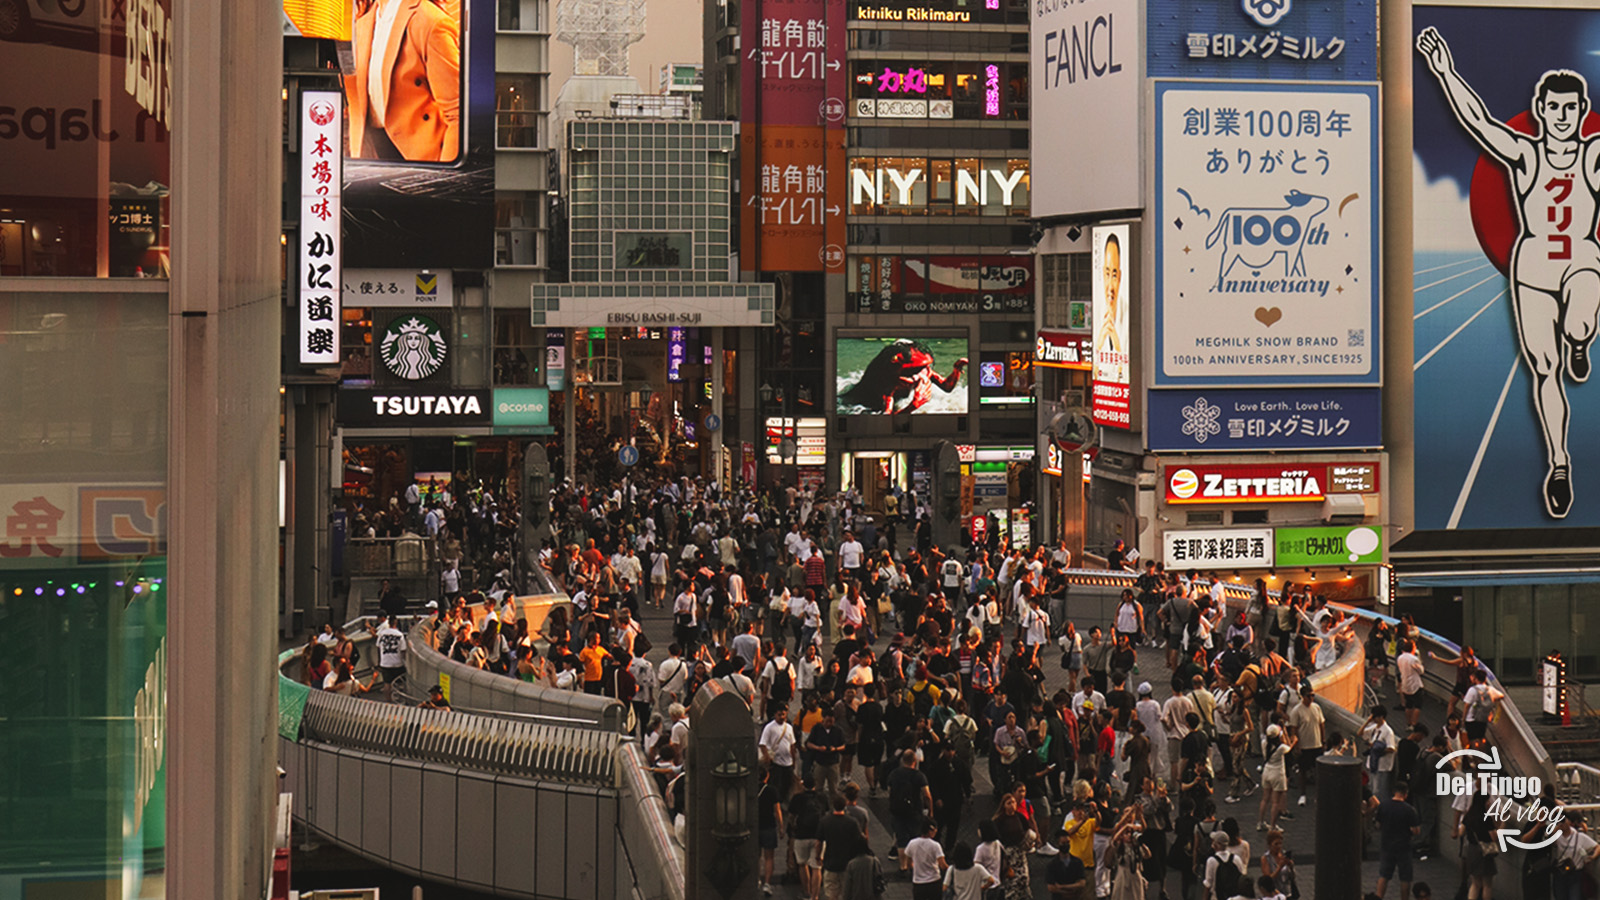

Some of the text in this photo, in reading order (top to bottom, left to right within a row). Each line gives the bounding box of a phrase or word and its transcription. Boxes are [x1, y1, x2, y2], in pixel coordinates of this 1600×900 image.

[906, 8, 970, 21] Rikimaru
[762, 18, 828, 48] 龍角散
[1045, 13, 1122, 90] FANCL
[1186, 31, 1346, 60] 雪印メグミルク
[878, 67, 927, 93] 力丸
[1183, 107, 1352, 138] 創業100周年
[1206, 148, 1330, 176] ありがとう
[309, 133, 333, 221] 本場の味
[762, 164, 828, 193] 龍角散
[853, 168, 1026, 206] NY NY
[1544, 173, 1575, 260] グリコ
[1209, 276, 1330, 297] Anniversary
[1045, 342, 1079, 362] ZETTERIA
[1195, 337, 1338, 347] MEGMILK SNOW BRAND
[1173, 355, 1204, 365] 100th
[372, 396, 481, 415] TSUTAYA
[499, 403, 544, 414] @cosme
[1235, 400, 1343, 411] Love Earth. Love Life.
[1228, 415, 1350, 438] 雪印メグミルク
[1203, 474, 1320, 496] ZETTERIA
[1306, 536, 1344, 555] ピタットハウス
